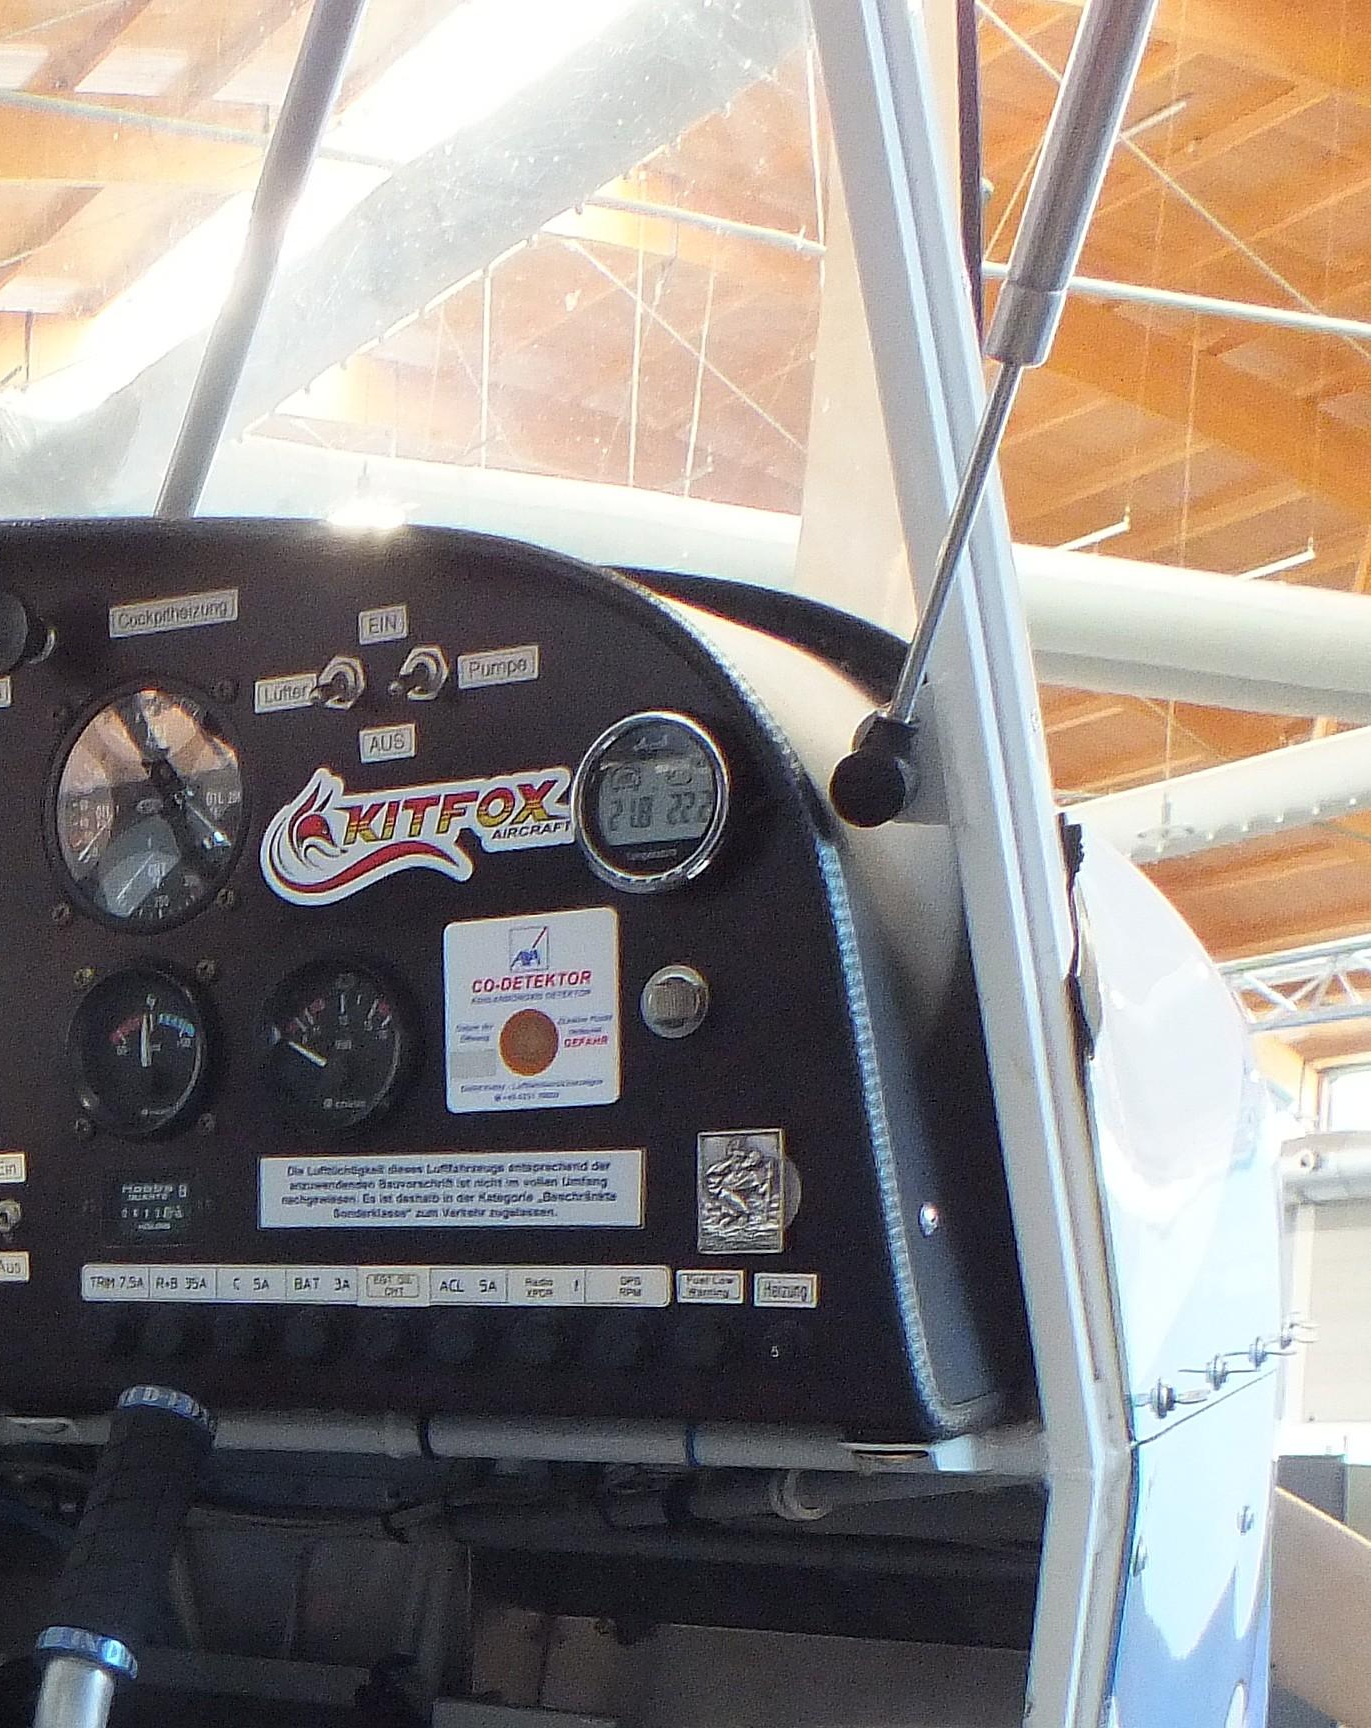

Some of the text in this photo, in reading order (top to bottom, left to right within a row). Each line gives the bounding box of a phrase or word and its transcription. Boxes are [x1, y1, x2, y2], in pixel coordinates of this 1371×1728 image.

[118, 600, 228, 629] Cockpitheizung
[368, 614, 397, 635] EIN
[467, 658, 528, 677] Pumpe
[368, 732, 406, 753] AUS
[334, 779, 558, 846] KITFOX
[490, 818, 572, 840] AIRCRAFT
[471, 969, 593, 994] CO-DETEKTOR
[563, 1036, 609, 1049] GEFAHR
[286, 1165, 305, 1177] Die
[387, 1163, 423, 1175] dieses
[507, 1160, 589, 1175] entsprechend
[591, 1160, 611, 1172] der
[378, 1177, 454, 1190] Bauvorschrift
[456, 1178, 471, 1189] ist
[473, 1177, 503, 1189] nicht
[504, 1177, 520, 1188] im
[522, 1175, 558, 1187] vollen
[561, 1174, 608, 1190] Umfang
[362, 1193, 376, 1204] Es
[378, 1193, 393, 1204] ist
[395, 1192, 440, 1204] deshalb
[442, 1191, 454, 1203] in
[456, 1191, 474, 1203] der
[477, 1190, 534, 1205] Kategorie
[414, 1208, 439, 1219] zum
[442, 1207, 485, 1218] Verkehr
[89, 1276, 116, 1290] TRIM
[184, 1276, 208, 1290] 35A
[252, 1277, 270, 1291] 5A
[294, 1276, 321, 1291] BAT
[333, 1277, 351, 1291] 3A
[439, 1278, 498, 1293] ACL 5A
[524, 1276, 554, 1287] Radio
[686, 1274, 734, 1285] Fuel Low
[619, 1287, 642, 1298] RPM
[686, 1287, 730, 1299] Warning
[763, 1281, 807, 1302] Heizung
